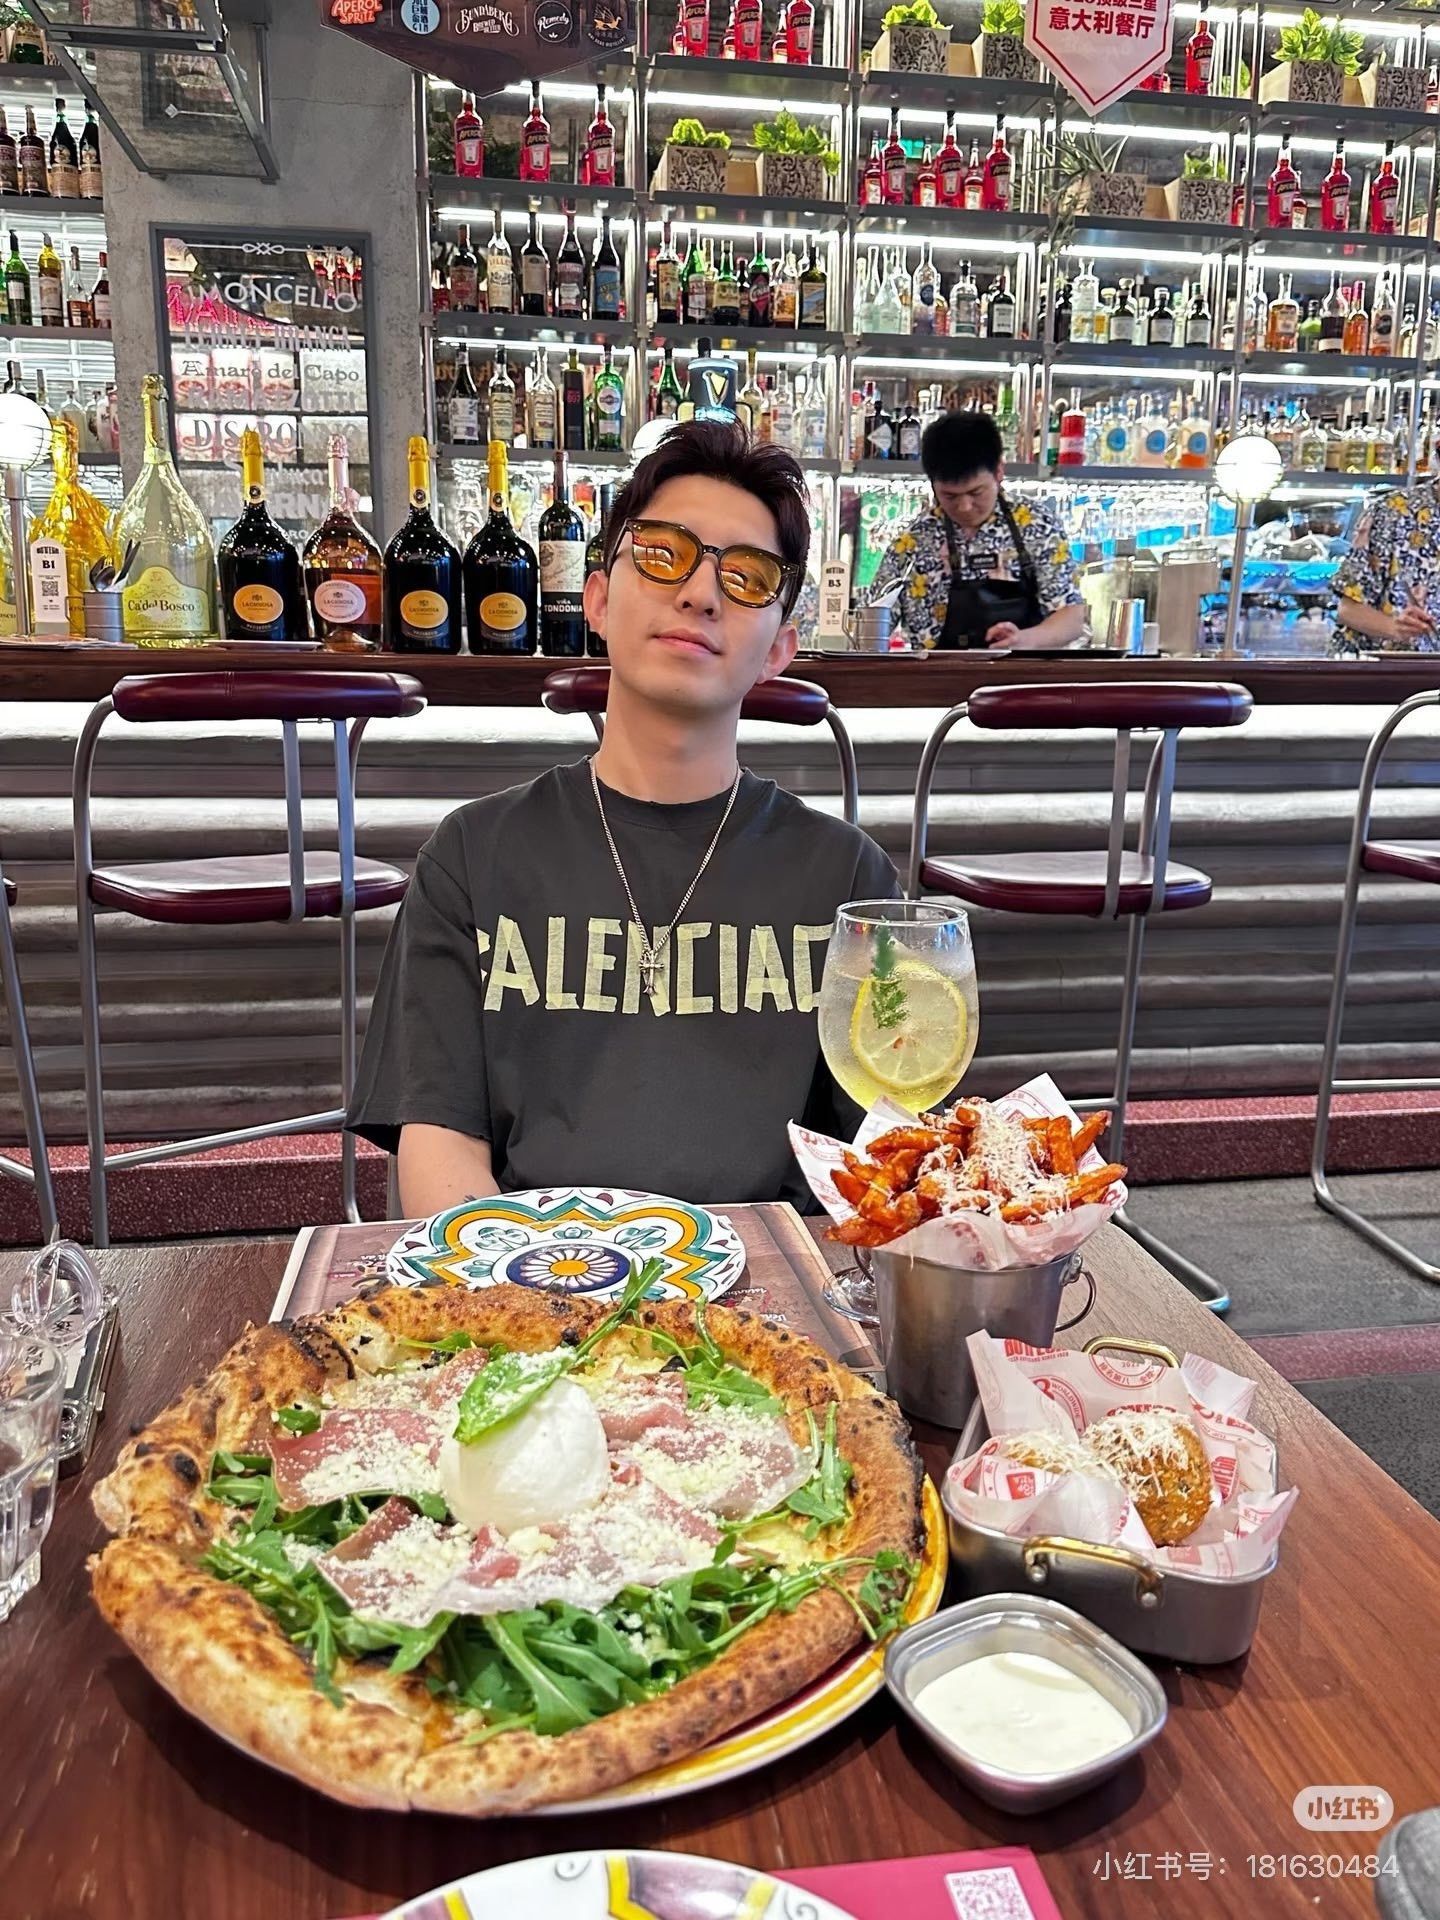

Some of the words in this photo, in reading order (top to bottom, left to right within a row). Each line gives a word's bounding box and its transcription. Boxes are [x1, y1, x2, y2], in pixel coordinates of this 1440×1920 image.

[331, 0, 383, 17] APEROL
[340, 11, 376, 24] SPRITZ
[455, 4, 519, 36] BUNDABERG
[537, 13, 570, 32] Remedy
[1049, 6, 1156, 39] 意大利餐厅
[182, 360, 261, 377] Amaro
[267, 363, 299, 379] del
[304, 364, 359, 385] Capo
[42, 560, 55, 569] B1
[159, 600, 195, 611] Bosco
[544, 604, 583, 612] TONDONIA
[1051, 1382, 1080, 1418] WORLDWIDE
